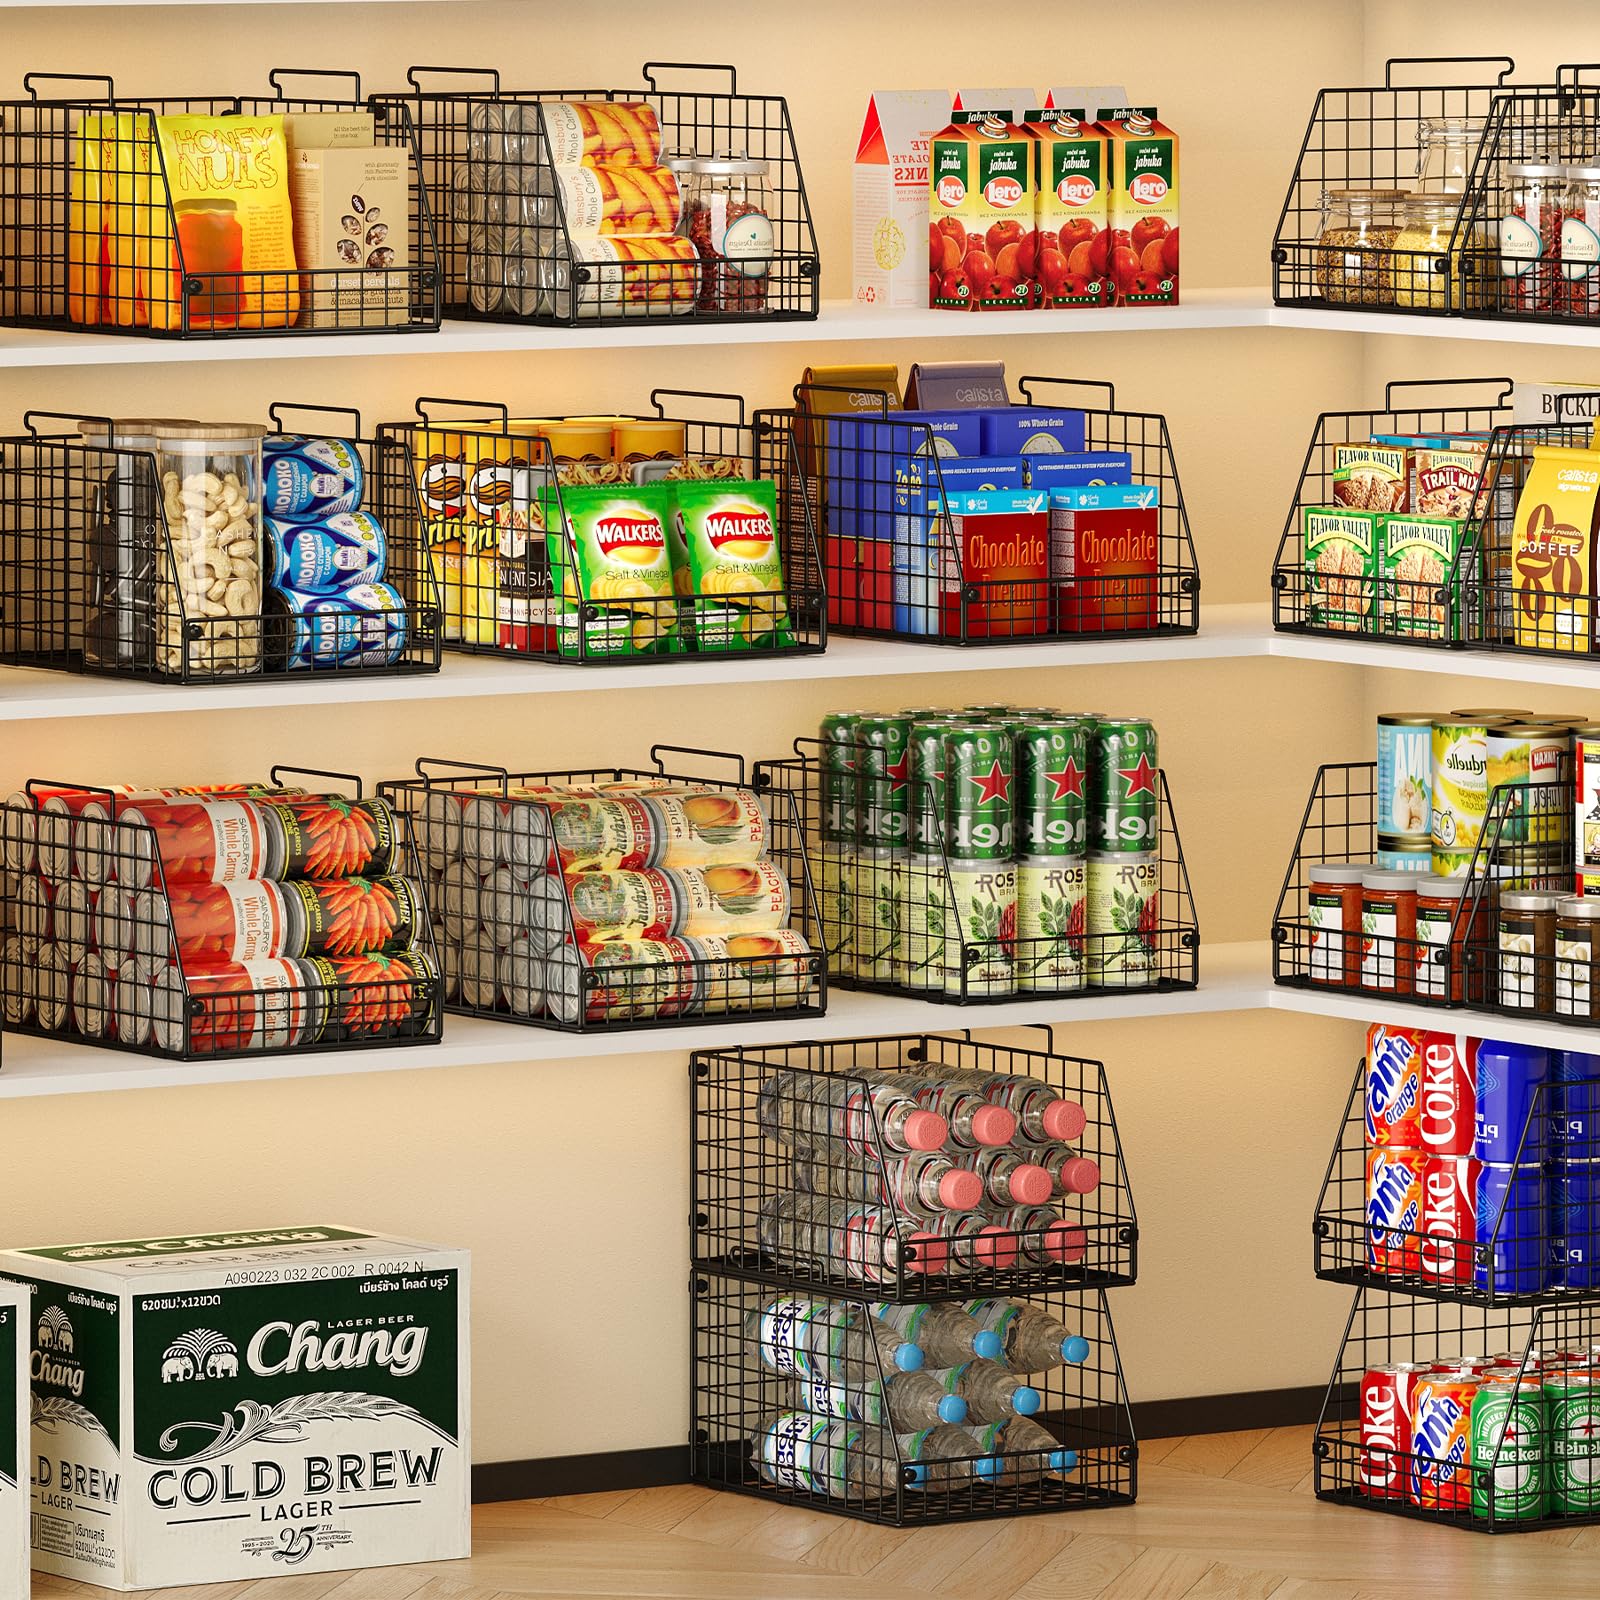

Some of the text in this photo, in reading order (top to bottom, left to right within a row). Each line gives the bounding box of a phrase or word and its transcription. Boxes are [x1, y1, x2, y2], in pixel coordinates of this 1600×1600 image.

[173, 127, 273, 154] HONEY
[566, 133, 578, 164] Whole
[940, 157, 961, 172] jabuka
[988, 158, 1018, 175] jabuka
[1061, 156, 1090, 172] jabuka
[1134, 155, 1163, 171] jabuka
[940, 180, 965, 202] Lero
[988, 182, 1022, 203] Lero
[1060, 180, 1094, 201] Lero
[1133, 178, 1166, 200] Lero
[585, 197, 598, 227] Whole
[1338, 449, 1402, 474] FLAVOR VALLEY
[1432, 454, 1474, 471] FLAVOR VALLEY
[1422, 472, 1459, 491] TRAIL
[596, 522, 663, 544] WALKERS
[706, 516, 773, 538] WALKERS
[1310, 517, 1371, 547] FLAVOR VALLEY
[1389, 524, 1451, 555] FLAVOR VALLEY
[970, 533, 1045, 569] Chocolate
[1081, 528, 1155, 564] Chocolate
[1519, 540, 1579, 556] COFFEE
[605, 571, 630, 582] Salt
[715, 565, 740, 575] Salt
[625, 803, 647, 853] APPLES
[670, 805, 681, 826] PIE
[735, 792, 763, 843] PEACHES
[223, 818, 241, 882] Whole Carrots
[645, 872, 669, 924] APPLES
[756, 860, 782, 912] PEACHES
[242, 896, 261, 961] Whole Carrots
[1366, 1025, 1414, 1143] Fanta
[1420, 1043, 1456, 1145] Coke
[1384, 1074, 1419, 1126] orange
[1366, 1152, 1414, 1270] Fanta
[1421, 1172, 1456, 1274] Coke
[223, 1270, 280, 1286] A090223
[284, 1267, 308, 1282] 032
[332, 1264, 355, 1279] 002
[364, 1263, 376, 1276] R
[378, 1261, 409, 1275] 0042
[414, 1260, 424, 1273] N
[327, 1314, 414, 1329] LAGER BEER
[246, 1319, 430, 1377] Chang
[29, 1350, 85, 1398] Chang
[1360, 1385, 1397, 1487] Coke
[1411, 1385, 1461, 1503] Fanta
[60, 1460, 121, 1505] BREW
[147, 1446, 445, 1510] COLD BREW
[41, 1491, 73, 1511] LAGER
[260, 1500, 333, 1521] LAGER
[271, 1524, 321, 1566] 25
